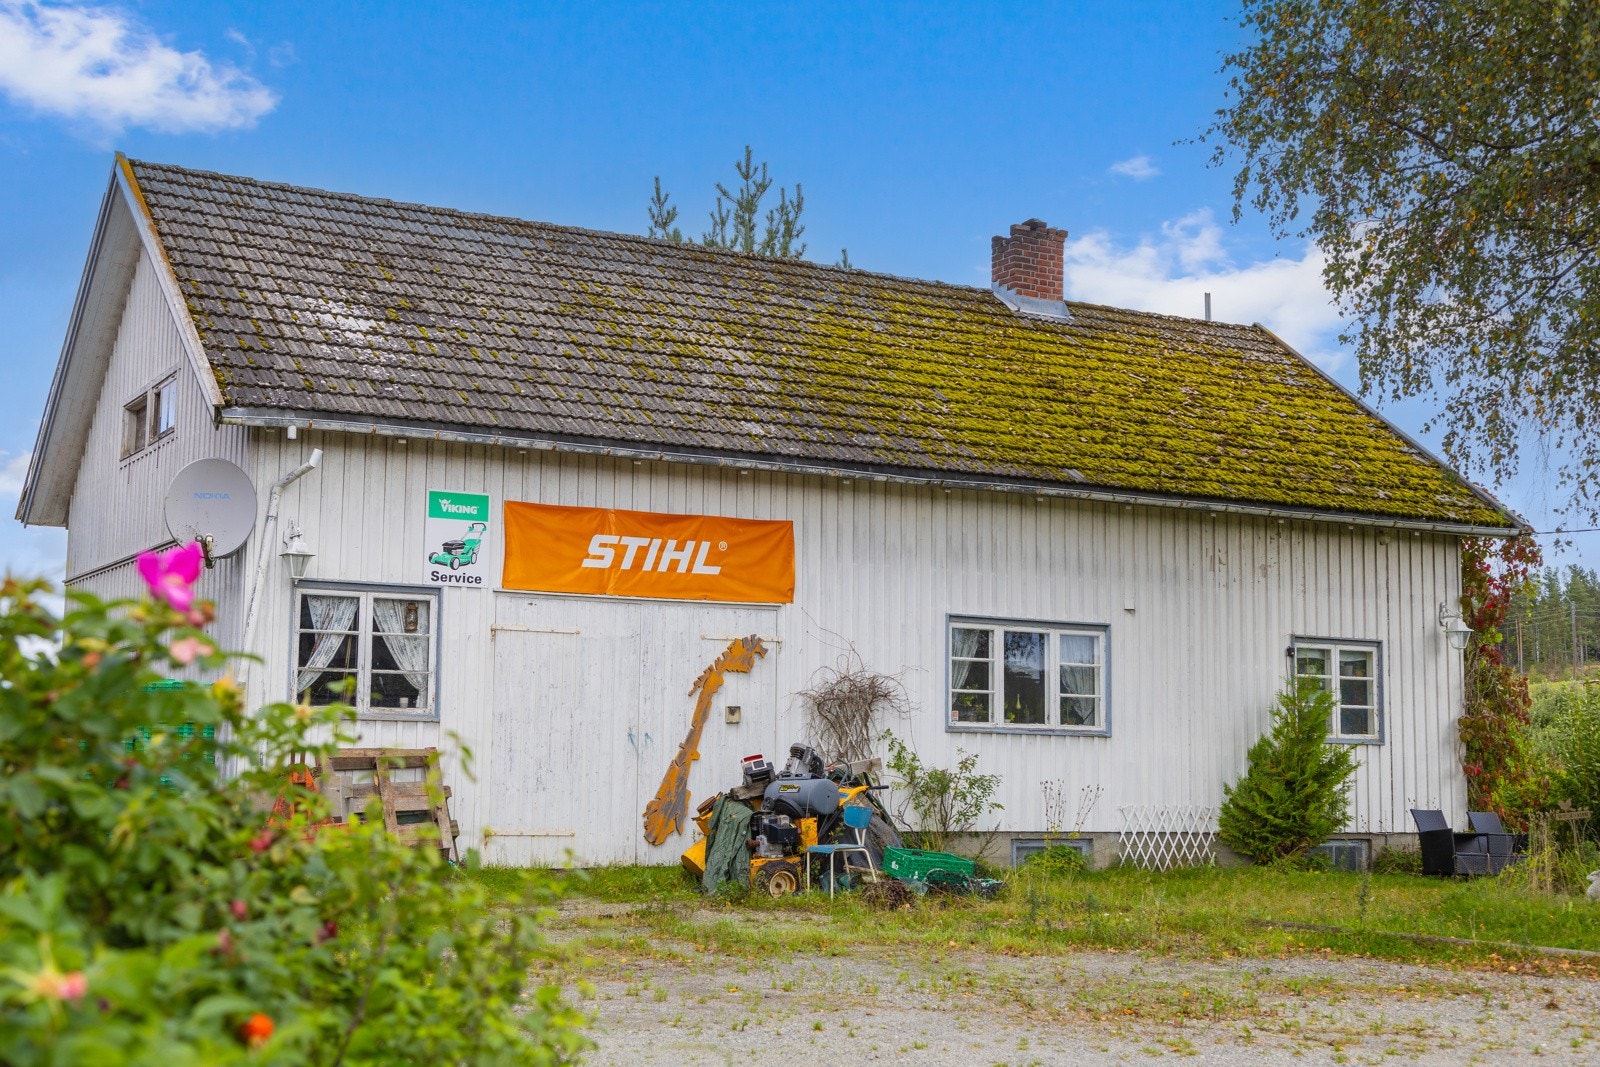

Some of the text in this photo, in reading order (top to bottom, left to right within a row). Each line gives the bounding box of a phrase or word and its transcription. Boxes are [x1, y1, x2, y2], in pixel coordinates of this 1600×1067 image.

[192, 492, 231, 500] NOKIA
[440, 500, 478, 514] VIKING
[430, 570, 482, 584] Service
